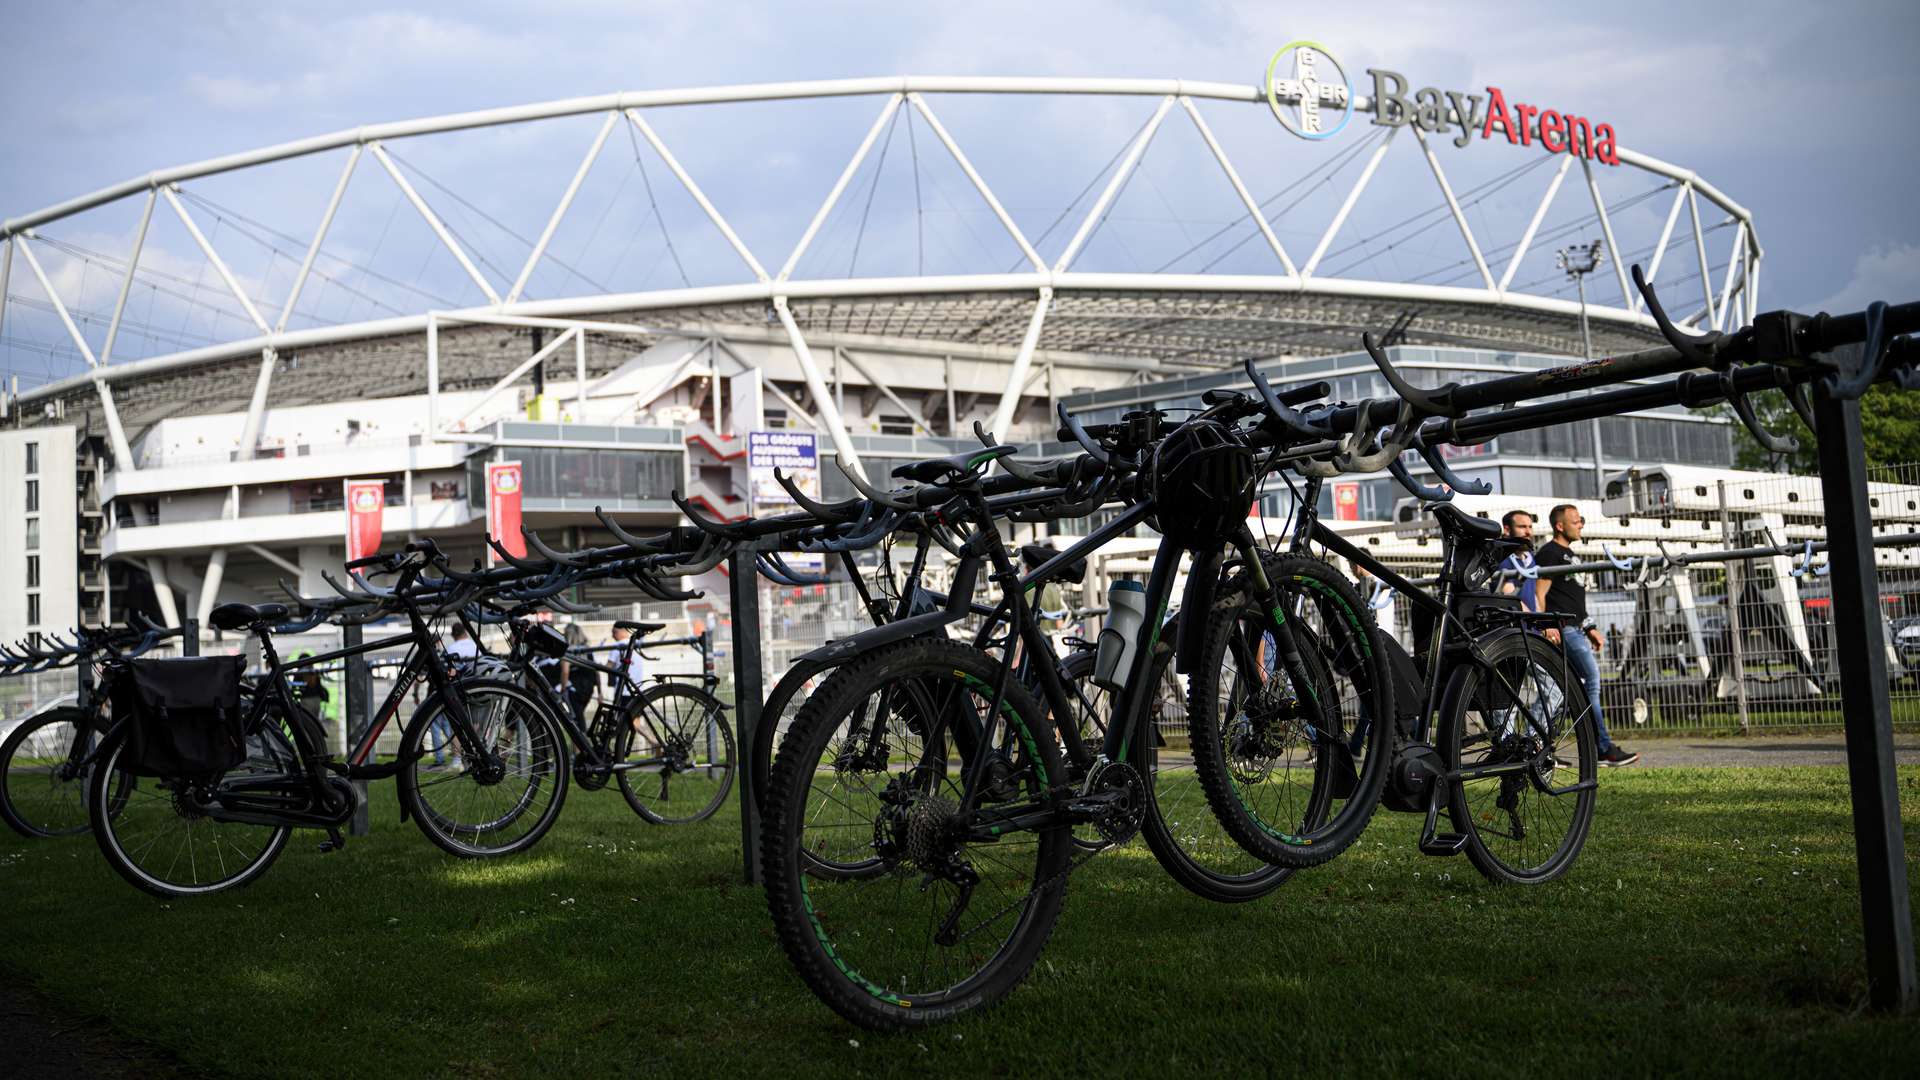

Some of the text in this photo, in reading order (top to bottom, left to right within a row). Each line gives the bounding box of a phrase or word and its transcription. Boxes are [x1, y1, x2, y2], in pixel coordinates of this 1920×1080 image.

[1275, 80, 1348, 103] BAYER
[1301, 50, 1321, 132] BAYER
[1366, 68, 1620, 166] BayArena
[751, 434, 769, 445] DIE
[752, 456, 774, 467] DER
